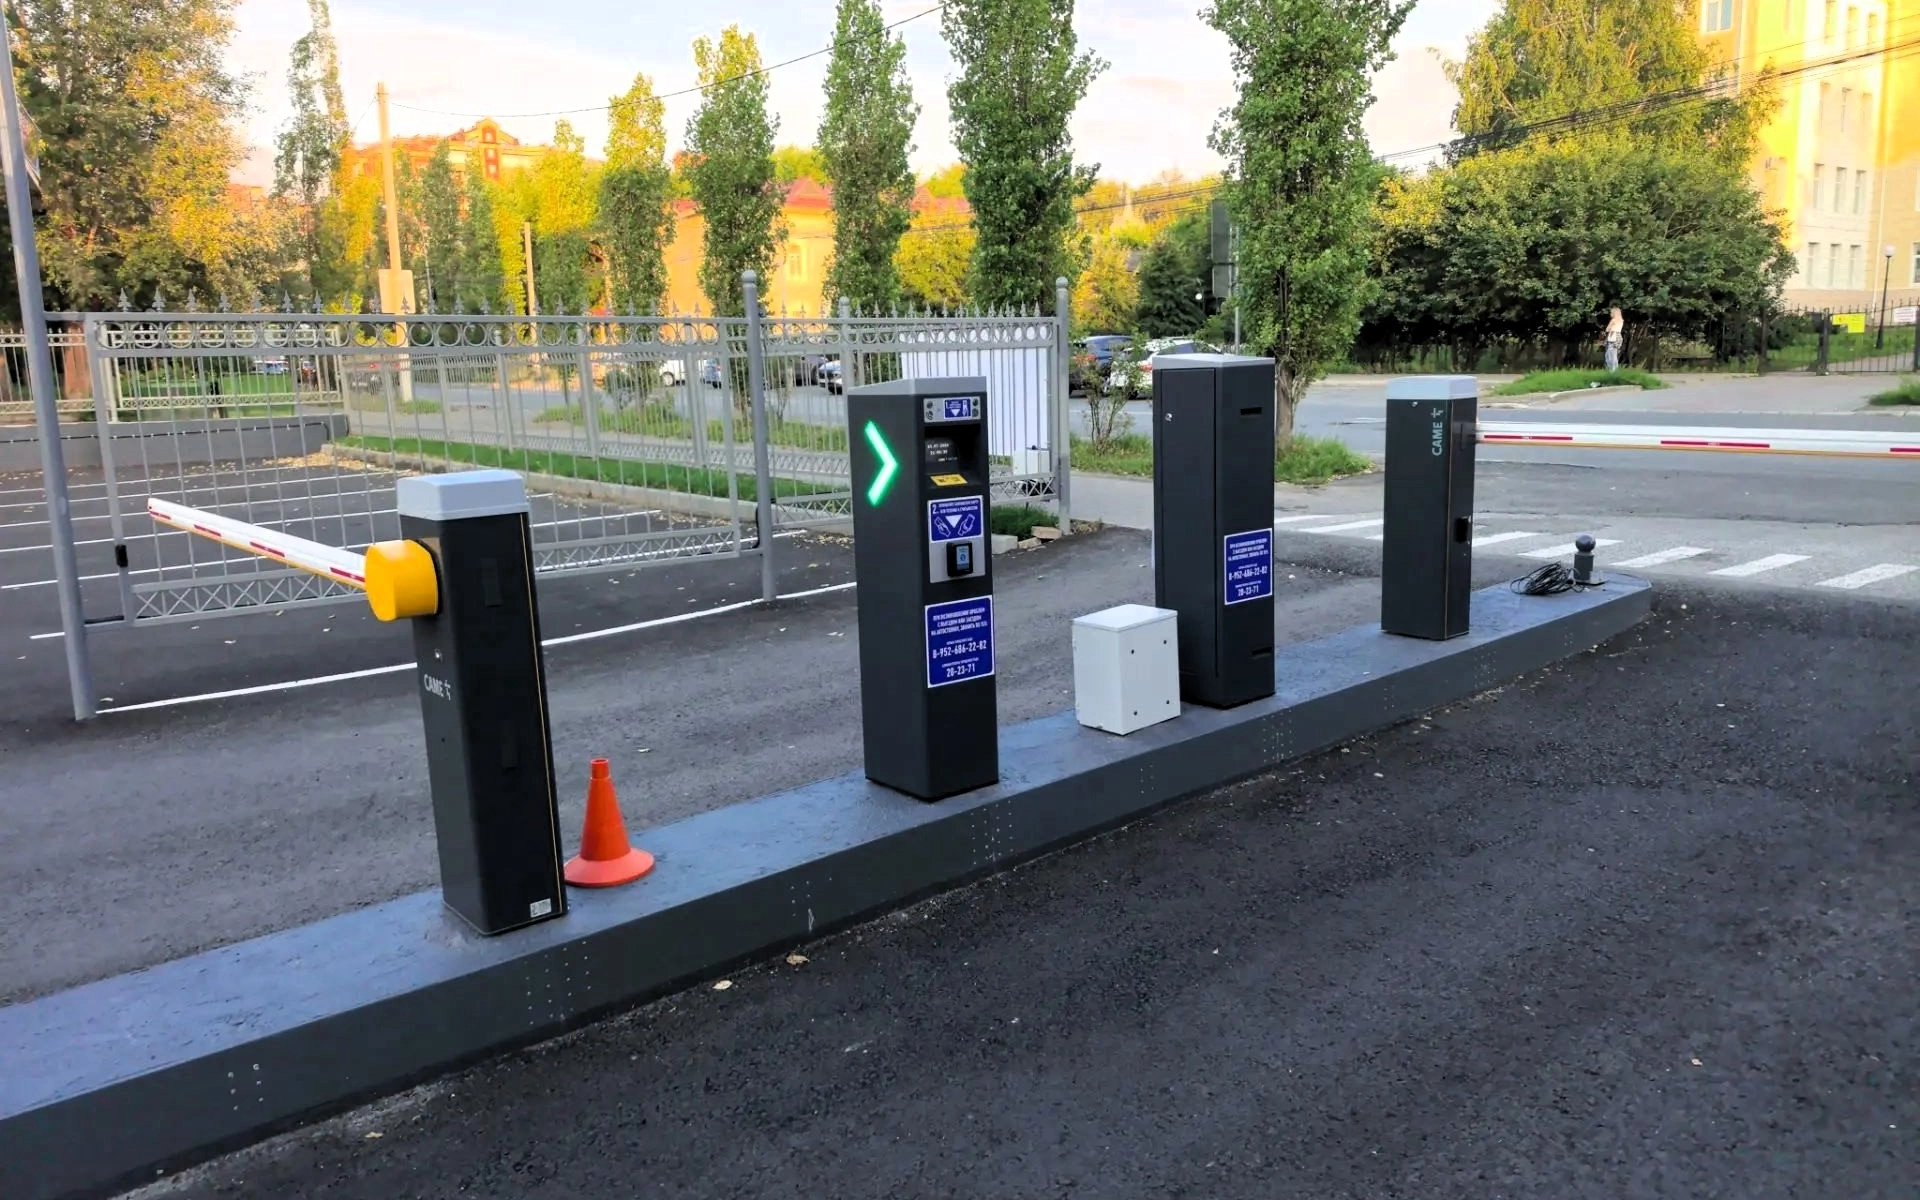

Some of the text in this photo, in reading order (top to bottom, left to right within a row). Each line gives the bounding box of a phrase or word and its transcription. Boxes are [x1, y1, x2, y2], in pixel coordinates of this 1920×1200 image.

[1431, 421, 1443, 456] CAME
[932, 639, 987, 659] 8-952-686-22-82
[946, 663, 976, 678] 20-23-71
[423, 673, 444, 698] CAME
